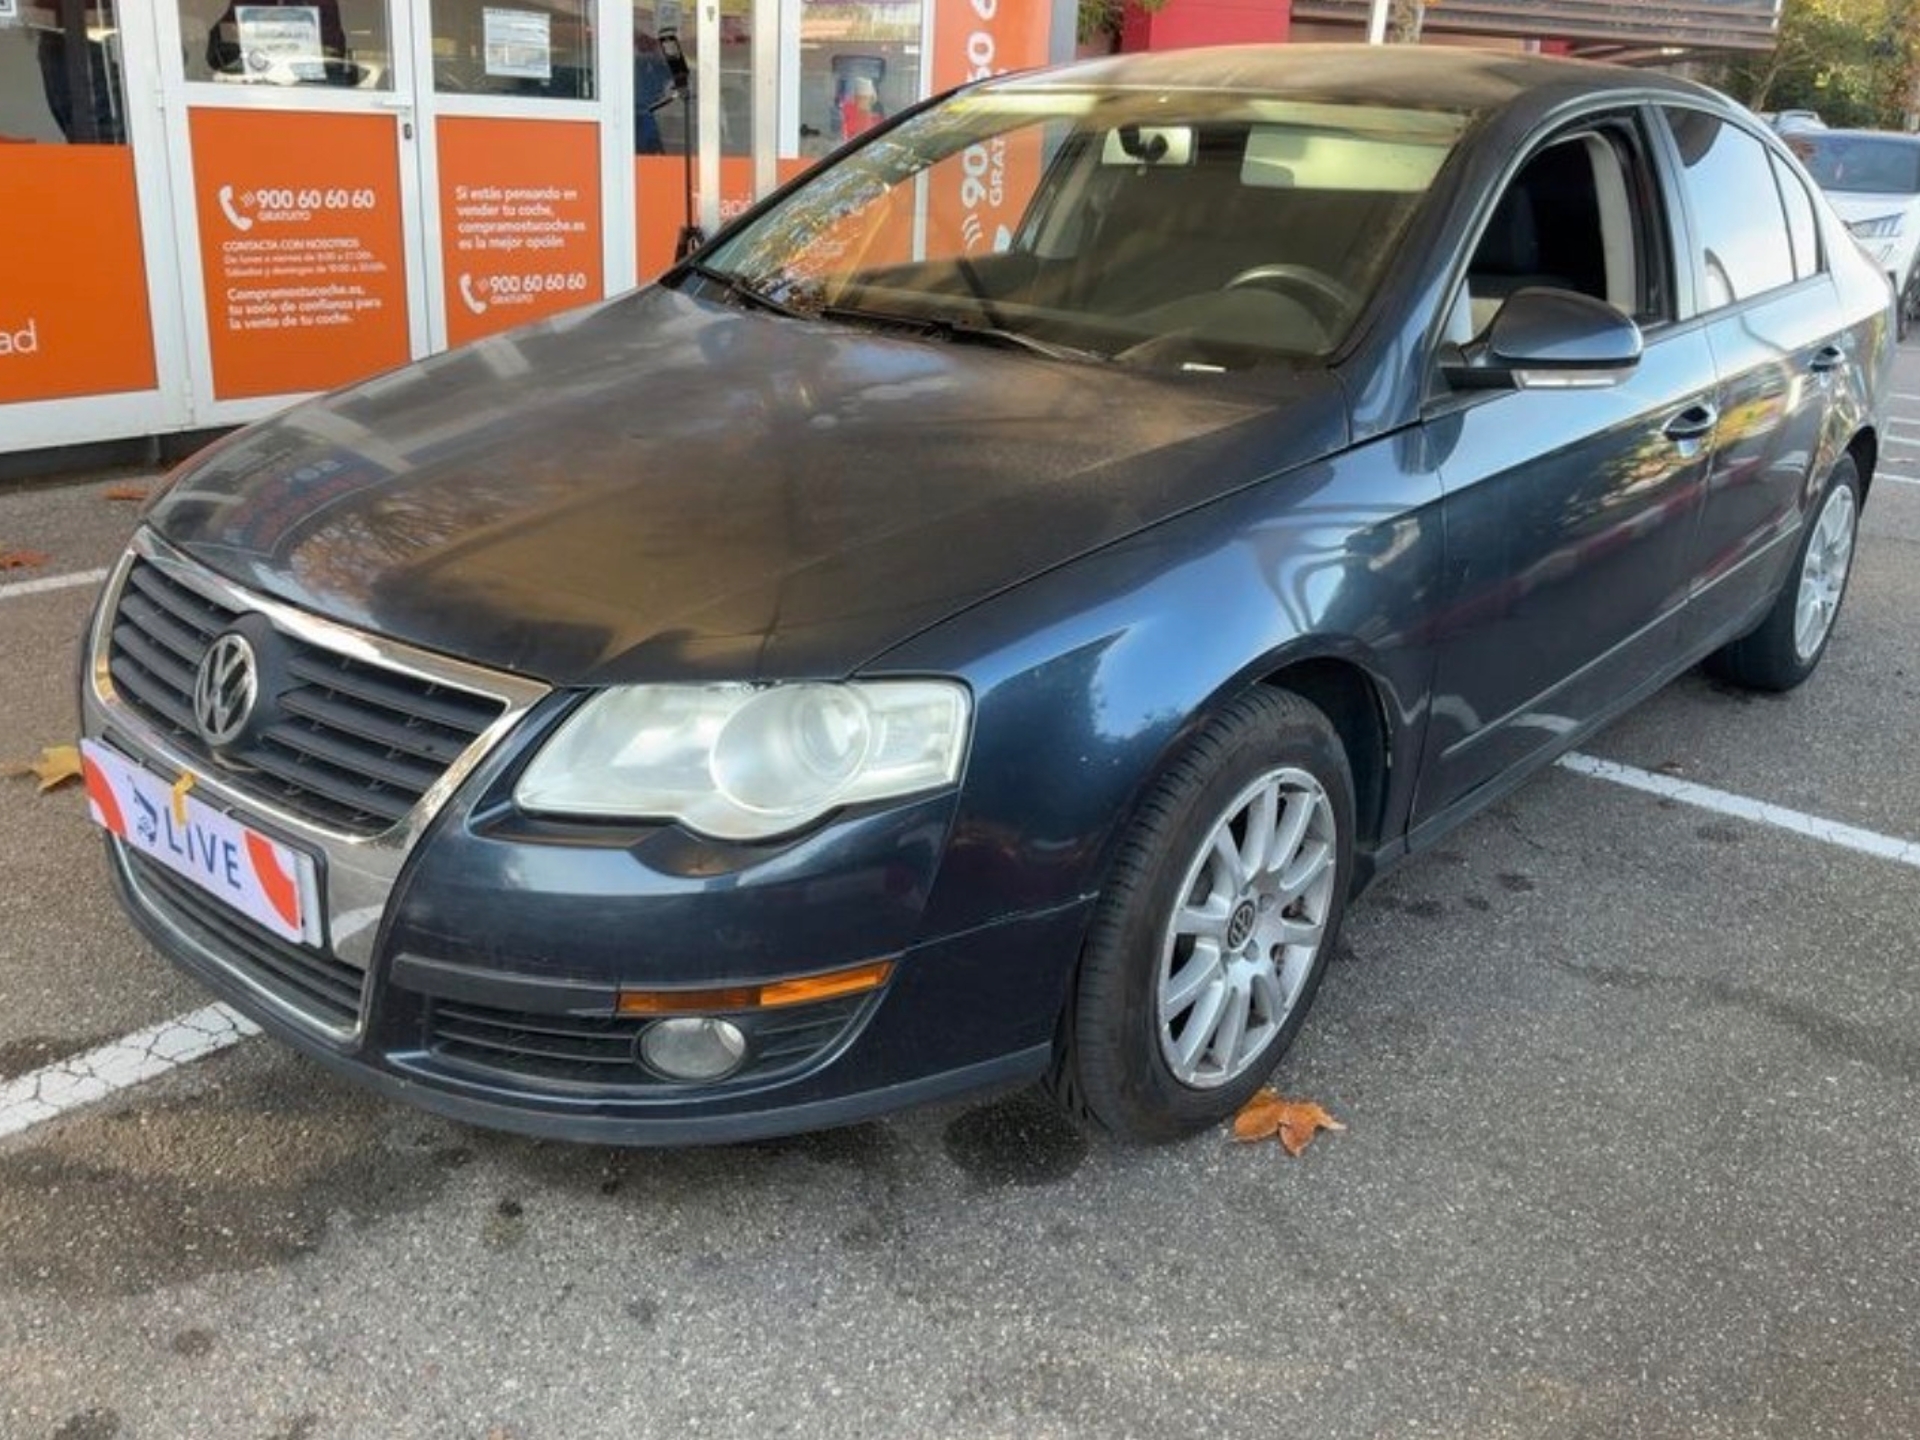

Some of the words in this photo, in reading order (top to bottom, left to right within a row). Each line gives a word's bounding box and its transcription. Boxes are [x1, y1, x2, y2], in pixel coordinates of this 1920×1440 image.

[256, 189, 294, 209] 900
[298, 189, 322, 209] 60
[324, 189, 349, 209] 60
[352, 189, 376, 209] 60
[455, 185, 468, 200] Si
[470, 186, 503, 200] estás
[504, 185, 560, 203] pensando
[563, 189, 578, 200] en
[257, 210, 312, 222] GRATUITO
[455, 202, 499, 217] vender
[502, 204, 516, 217] tu
[458, 218, 586, 236] compramostucoche.es
[221, 239, 278, 251] CONTACTA
[305, 237, 360, 249] NOSOTROS
[458, 238, 473, 250] es
[474, 235, 487, 250] la
[488, 237, 522, 253] mejor
[525, 234, 566, 252] opción
[490, 275, 521, 293] 900
[523, 273, 544, 292] 60
[545, 273, 566, 291] 60
[566, 272, 587, 290] 60
[228, 303, 243, 316] tu
[279, 300, 297, 313] de
[298, 298, 354, 312] confianza
[355, 298, 382, 312] para
[229, 317, 242, 330] la
[244, 316, 280, 329] venta
[281, 314, 298, 328] de
[301, 314, 314, 328] tu
[163, 806, 242, 890] LIVE
